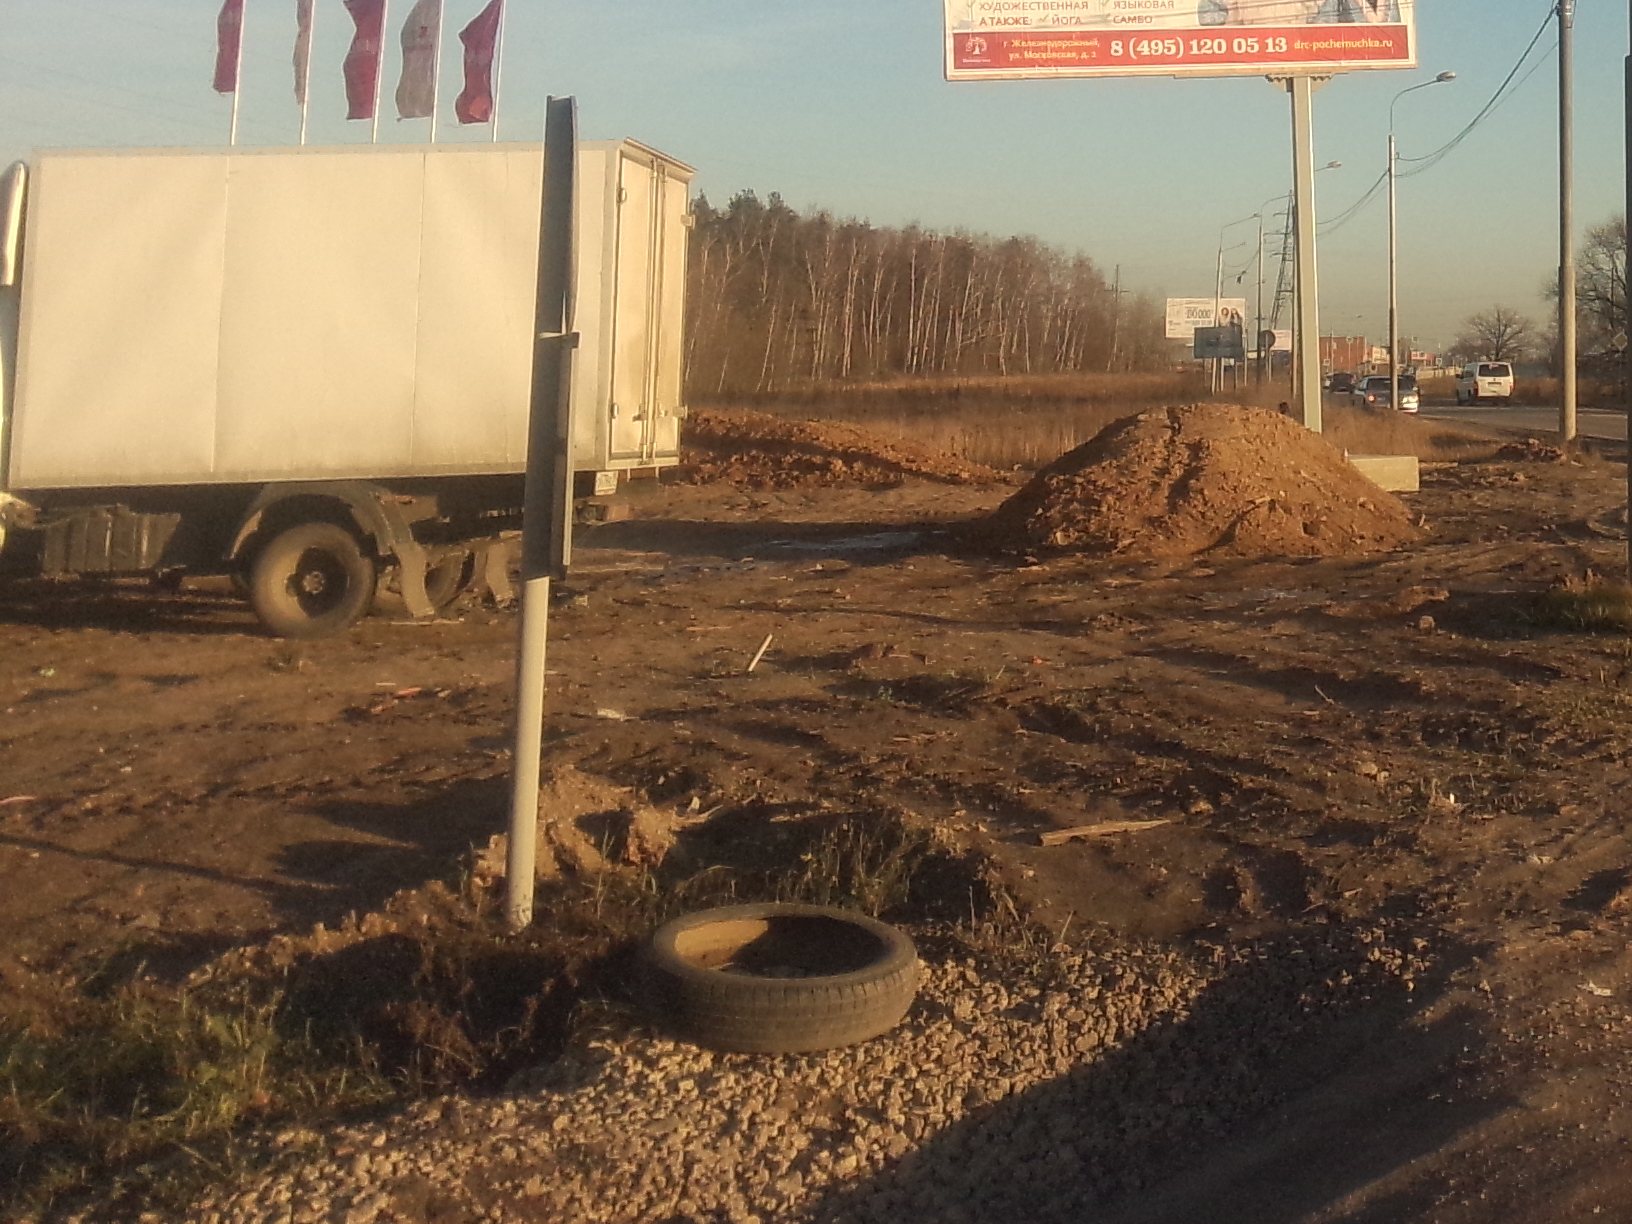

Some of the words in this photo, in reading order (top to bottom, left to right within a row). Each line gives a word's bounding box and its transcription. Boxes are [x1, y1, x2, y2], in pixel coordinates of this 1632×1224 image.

[979, 1, 1089, 13] ХУДОЖЕСТВЕННАЯ
[1113, 0, 1175, 10] ЯЗЫКОВАЯ
[1052, 14, 1082, 25] ЙОГА
[1113, 15, 1153, 24] САМБО
[1110, 40, 1123, 55] 8
[1129, 37, 1184, 59] (495)
[1189, 37, 1226, 55] 120
[1233, 37, 1259, 54] 05
[1265, 36, 1287, 52] 13
